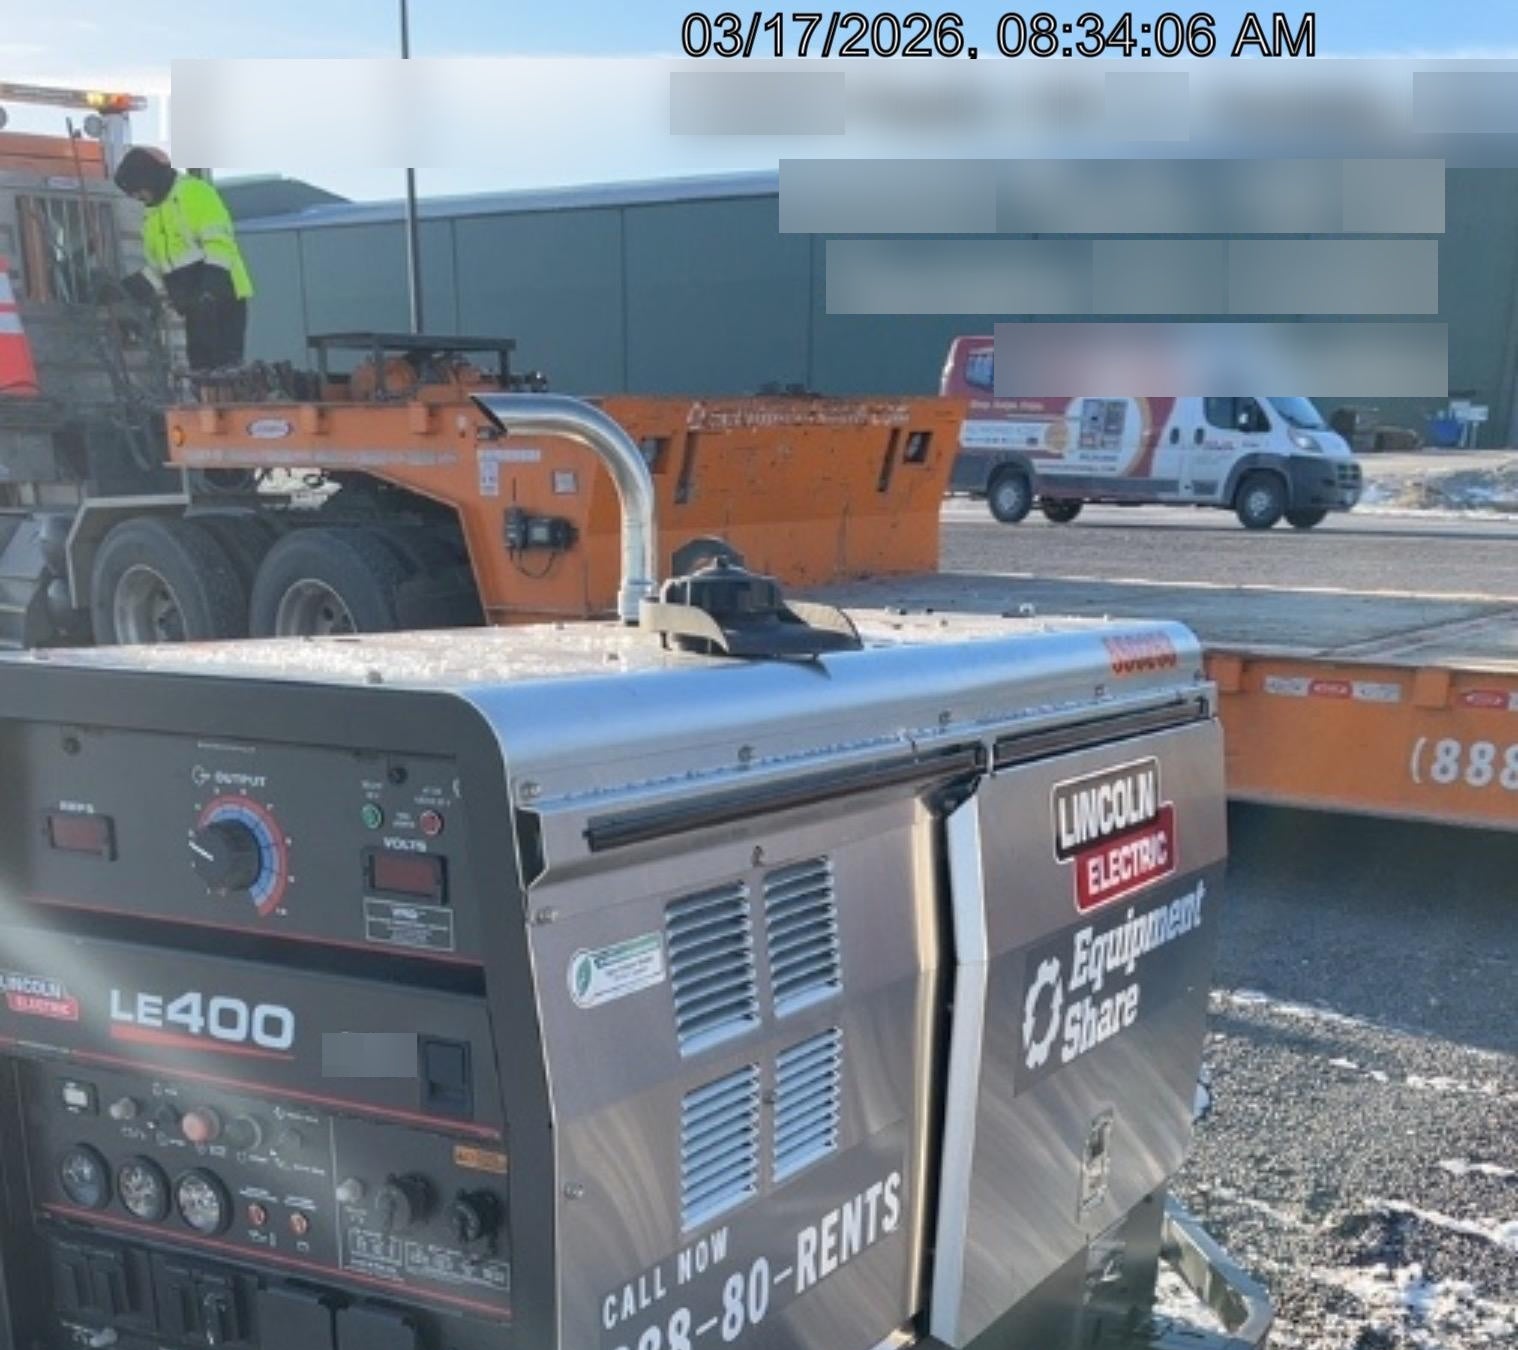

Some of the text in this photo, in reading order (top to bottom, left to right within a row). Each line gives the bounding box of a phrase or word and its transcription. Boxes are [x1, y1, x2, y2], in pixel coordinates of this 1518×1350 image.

[383, 837, 427, 852] VOLTS
[1057, 770, 1156, 850] LINCOLN
[1088, 831, 1169, 896] ELECTRIC
[1068, 879, 1206, 992] Equipment
[110, 989, 295, 1050] LE400
[1061, 983, 1141, 1064] Share
[603, 1227, 729, 1330] CALL NOW
